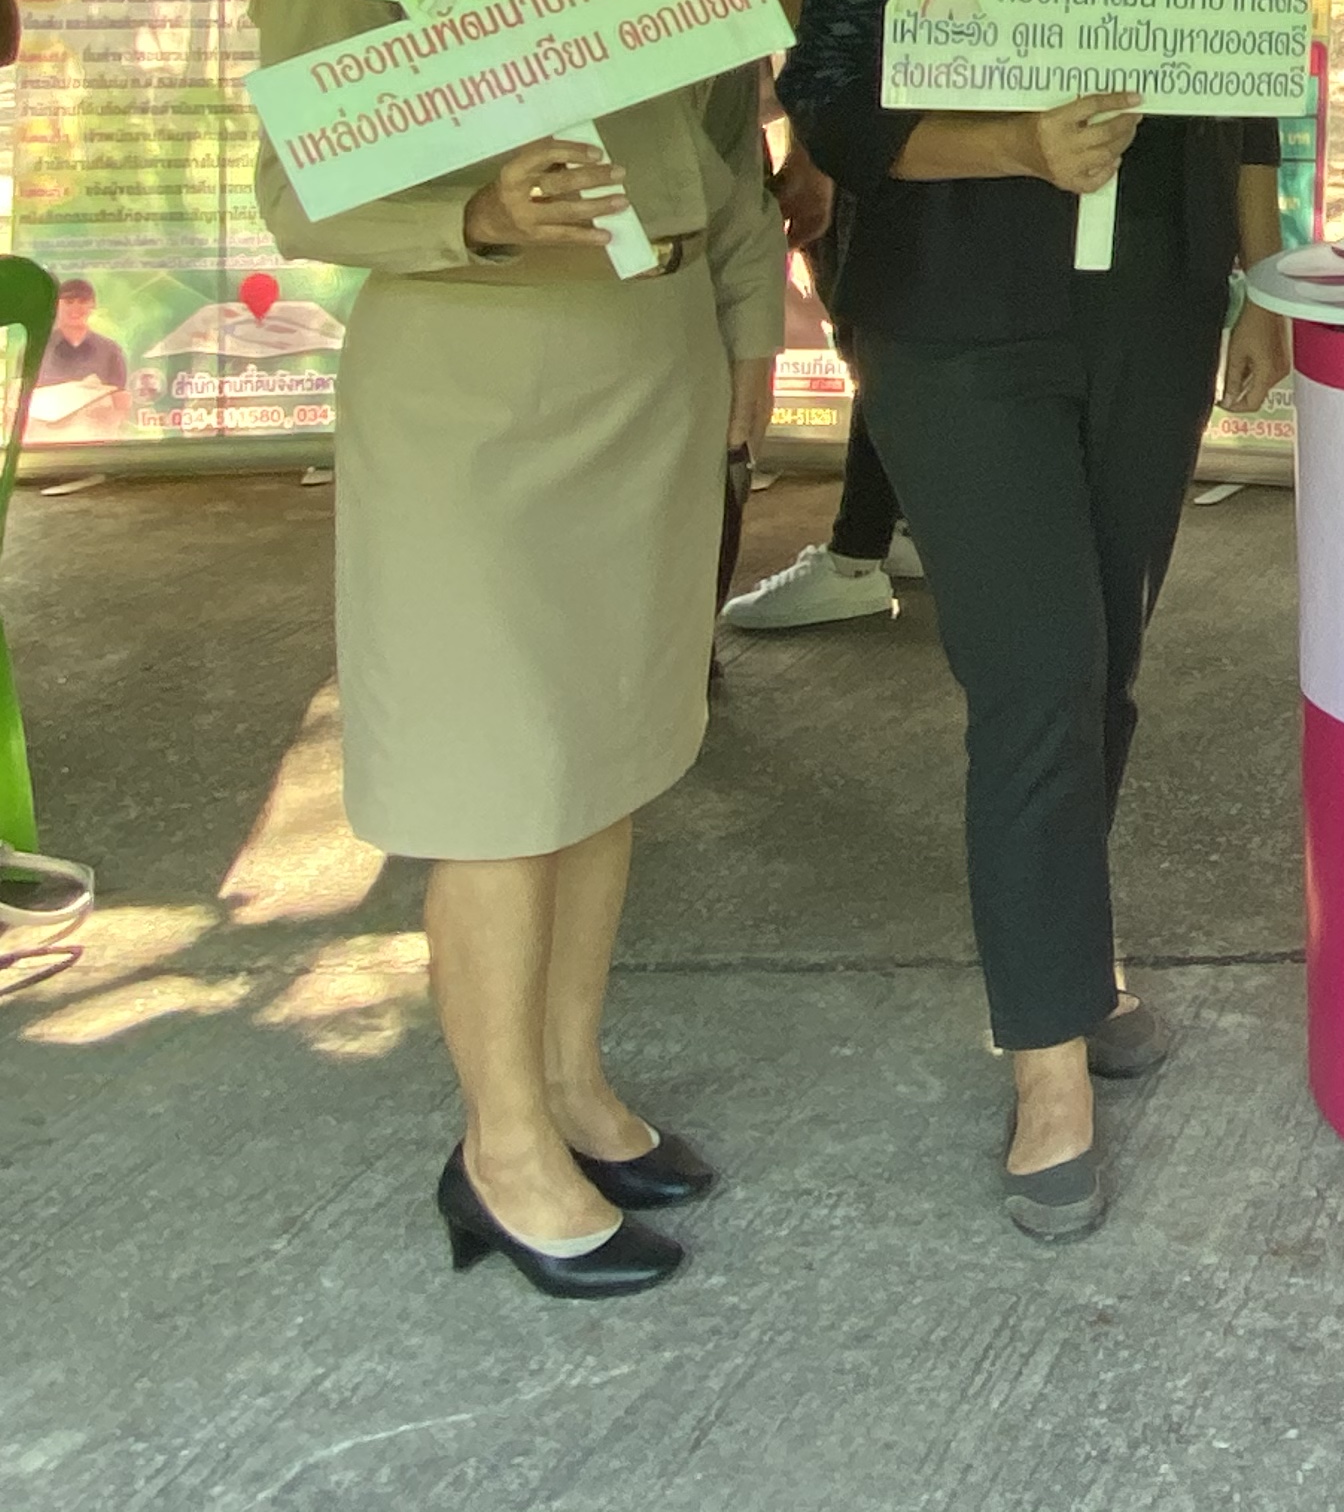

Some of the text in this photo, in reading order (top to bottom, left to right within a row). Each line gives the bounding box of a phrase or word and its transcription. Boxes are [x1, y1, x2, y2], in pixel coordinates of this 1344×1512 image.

[1011, 25, 1064, 58] ดูแล
[1078, 15, 1308, 58] แก้ไขปัญหาของสตรี
[889, 54, 1307, 99] ส่งเสริมพัฒนาคุณภาพชีวิตของสตรี
[284, 30, 610, 170] แหล่งเงินทุนหมุนเวียน
